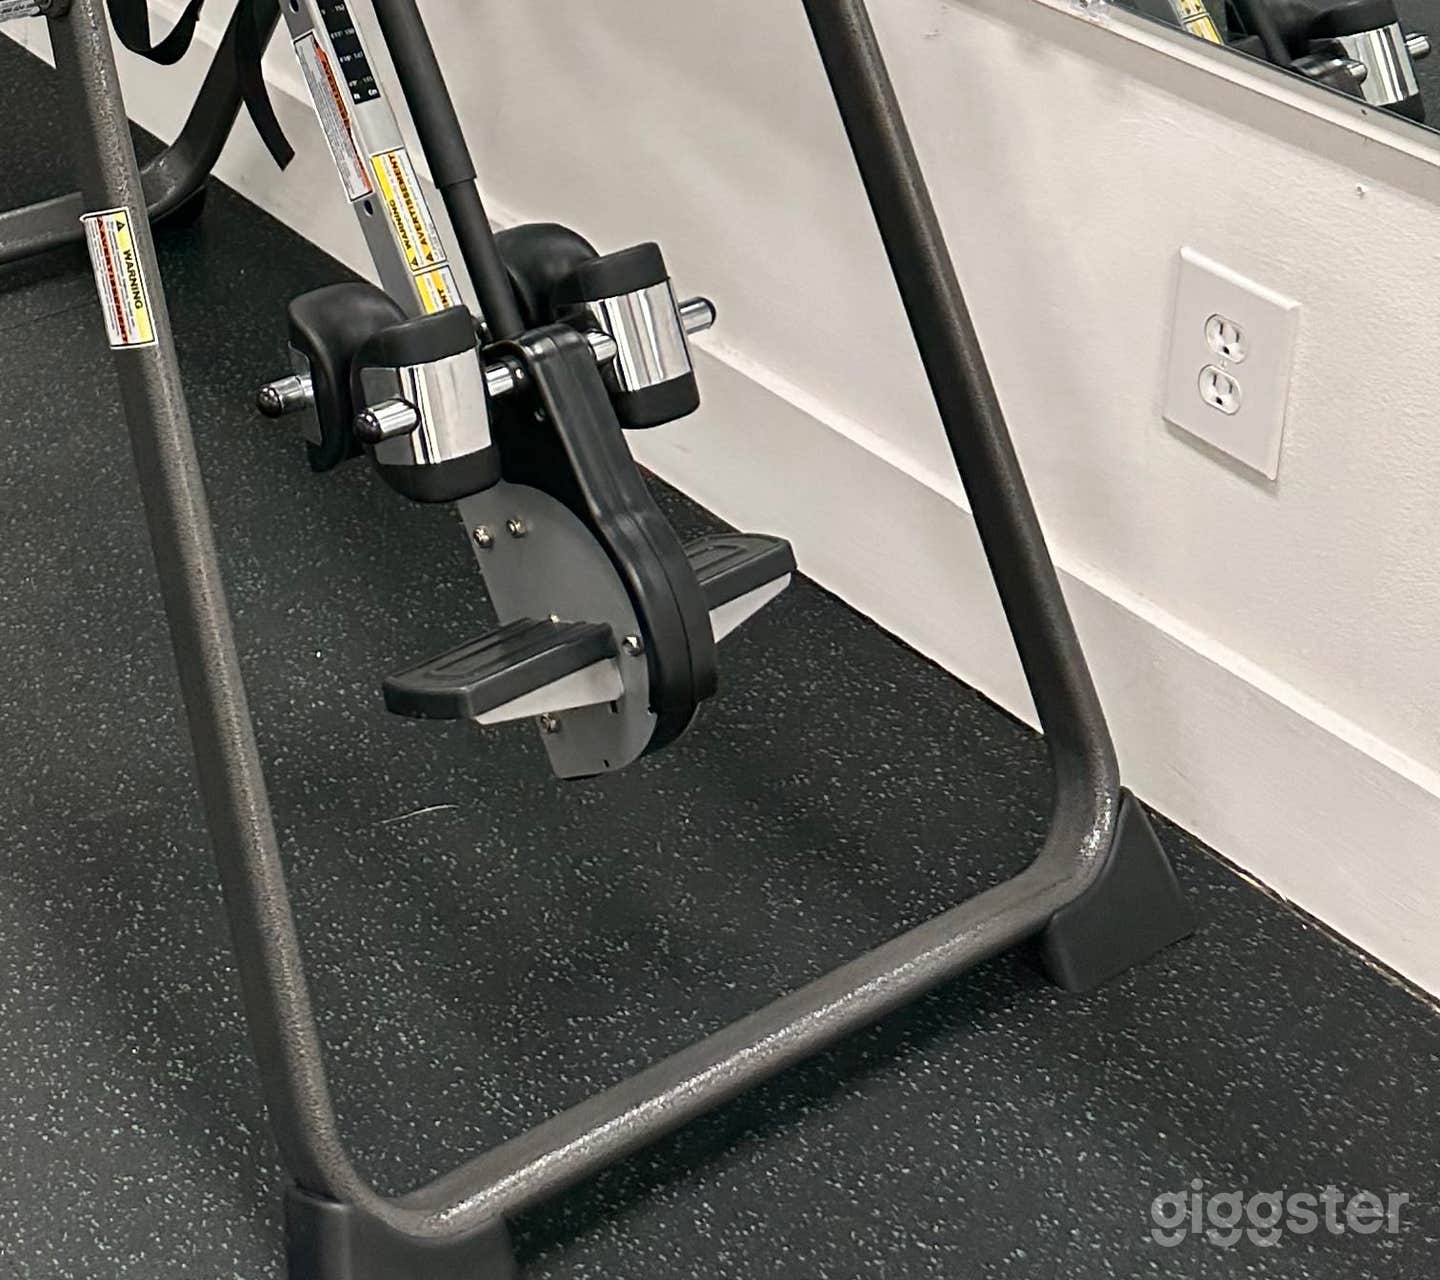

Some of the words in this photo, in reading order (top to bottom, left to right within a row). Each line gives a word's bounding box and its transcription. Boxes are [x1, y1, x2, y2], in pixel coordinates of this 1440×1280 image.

[388, 197, 414, 253] WARNING
[389, 152, 430, 247] AVERTISSEMENT
[121, 248, 145, 311] WARNING
